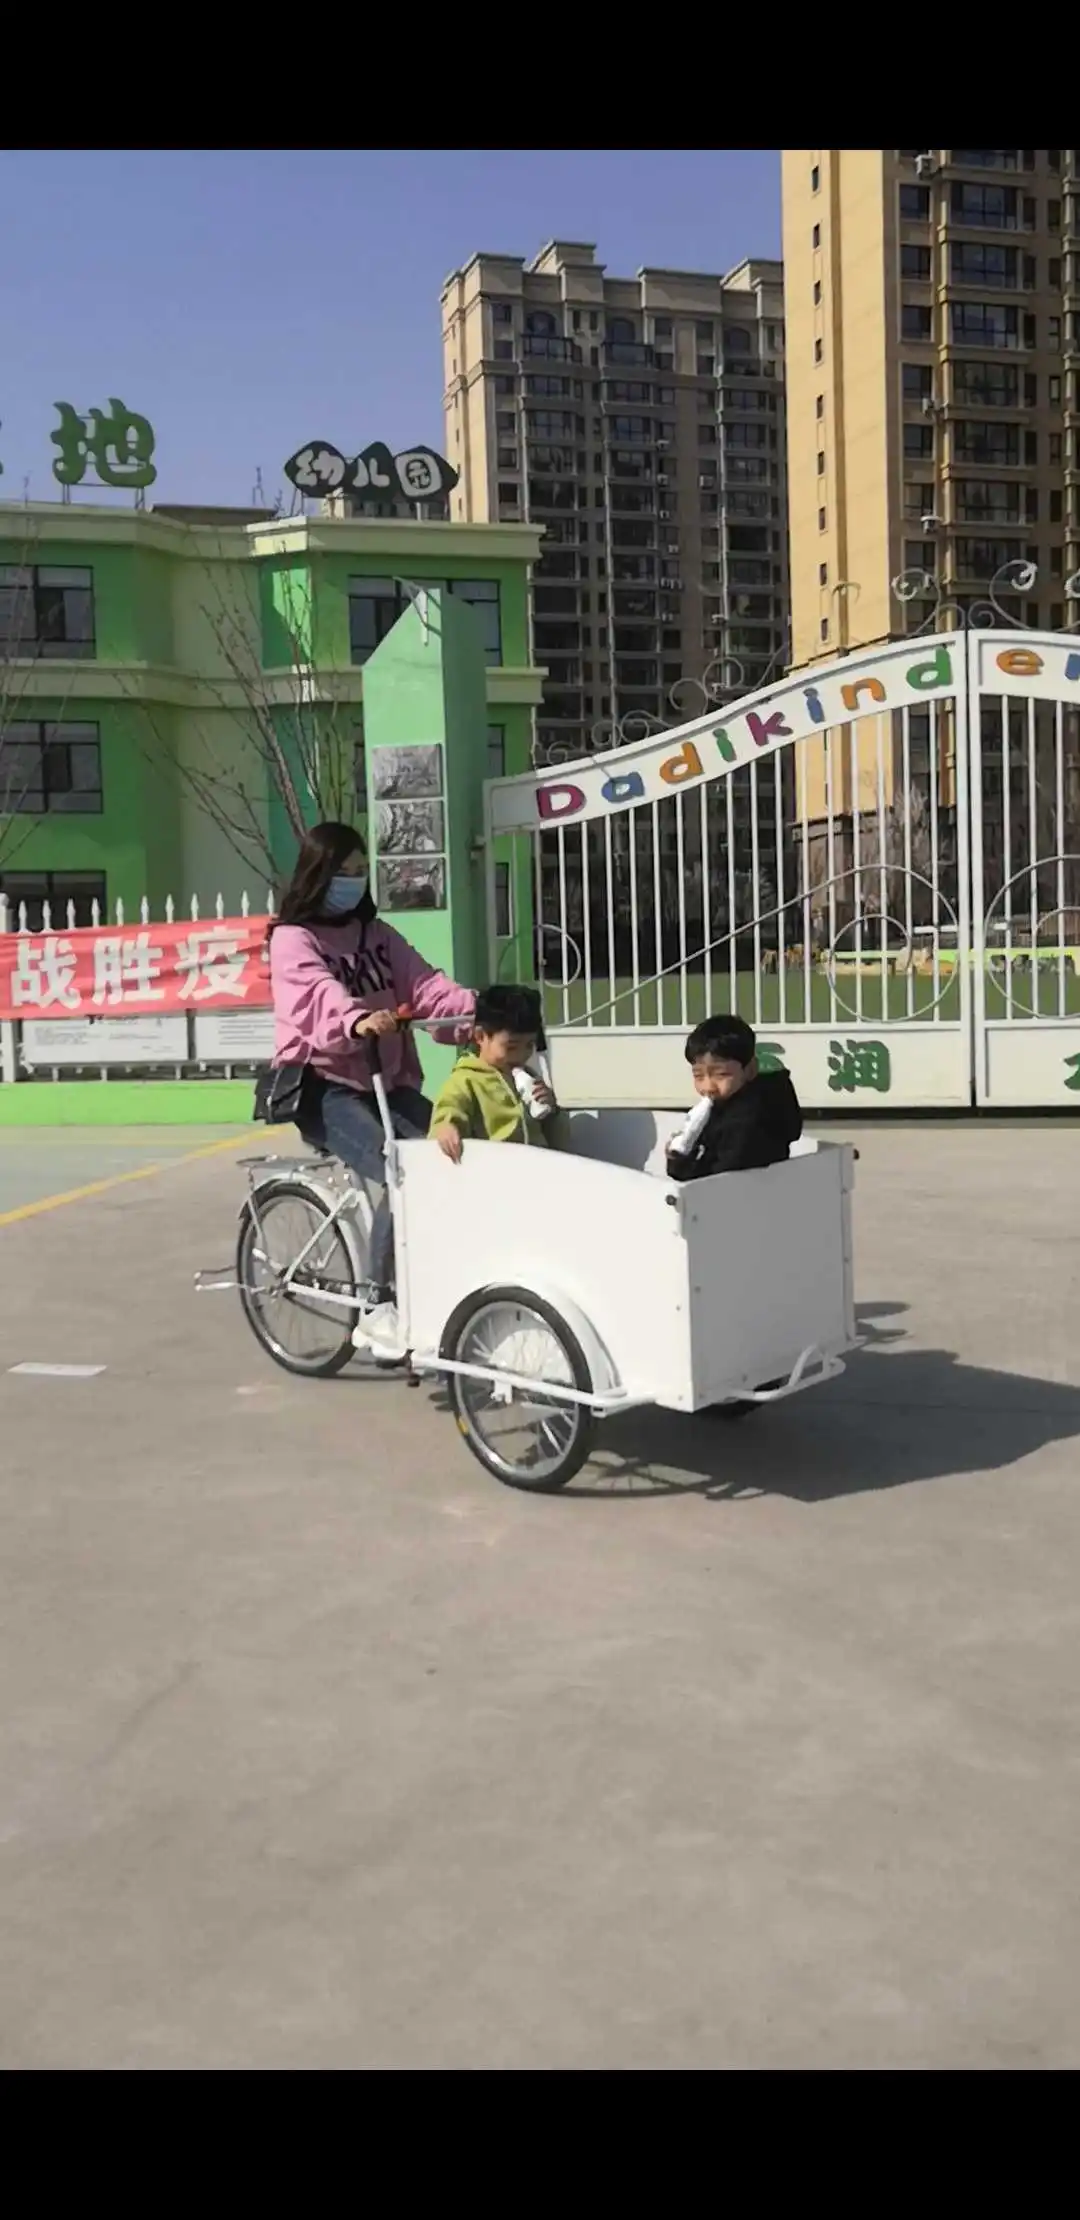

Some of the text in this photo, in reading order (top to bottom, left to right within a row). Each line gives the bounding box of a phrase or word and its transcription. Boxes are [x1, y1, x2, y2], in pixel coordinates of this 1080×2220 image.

[51, 397, 442, 497] 地 幼儿园
[11, 925, 269, 1009] 战胜疫
